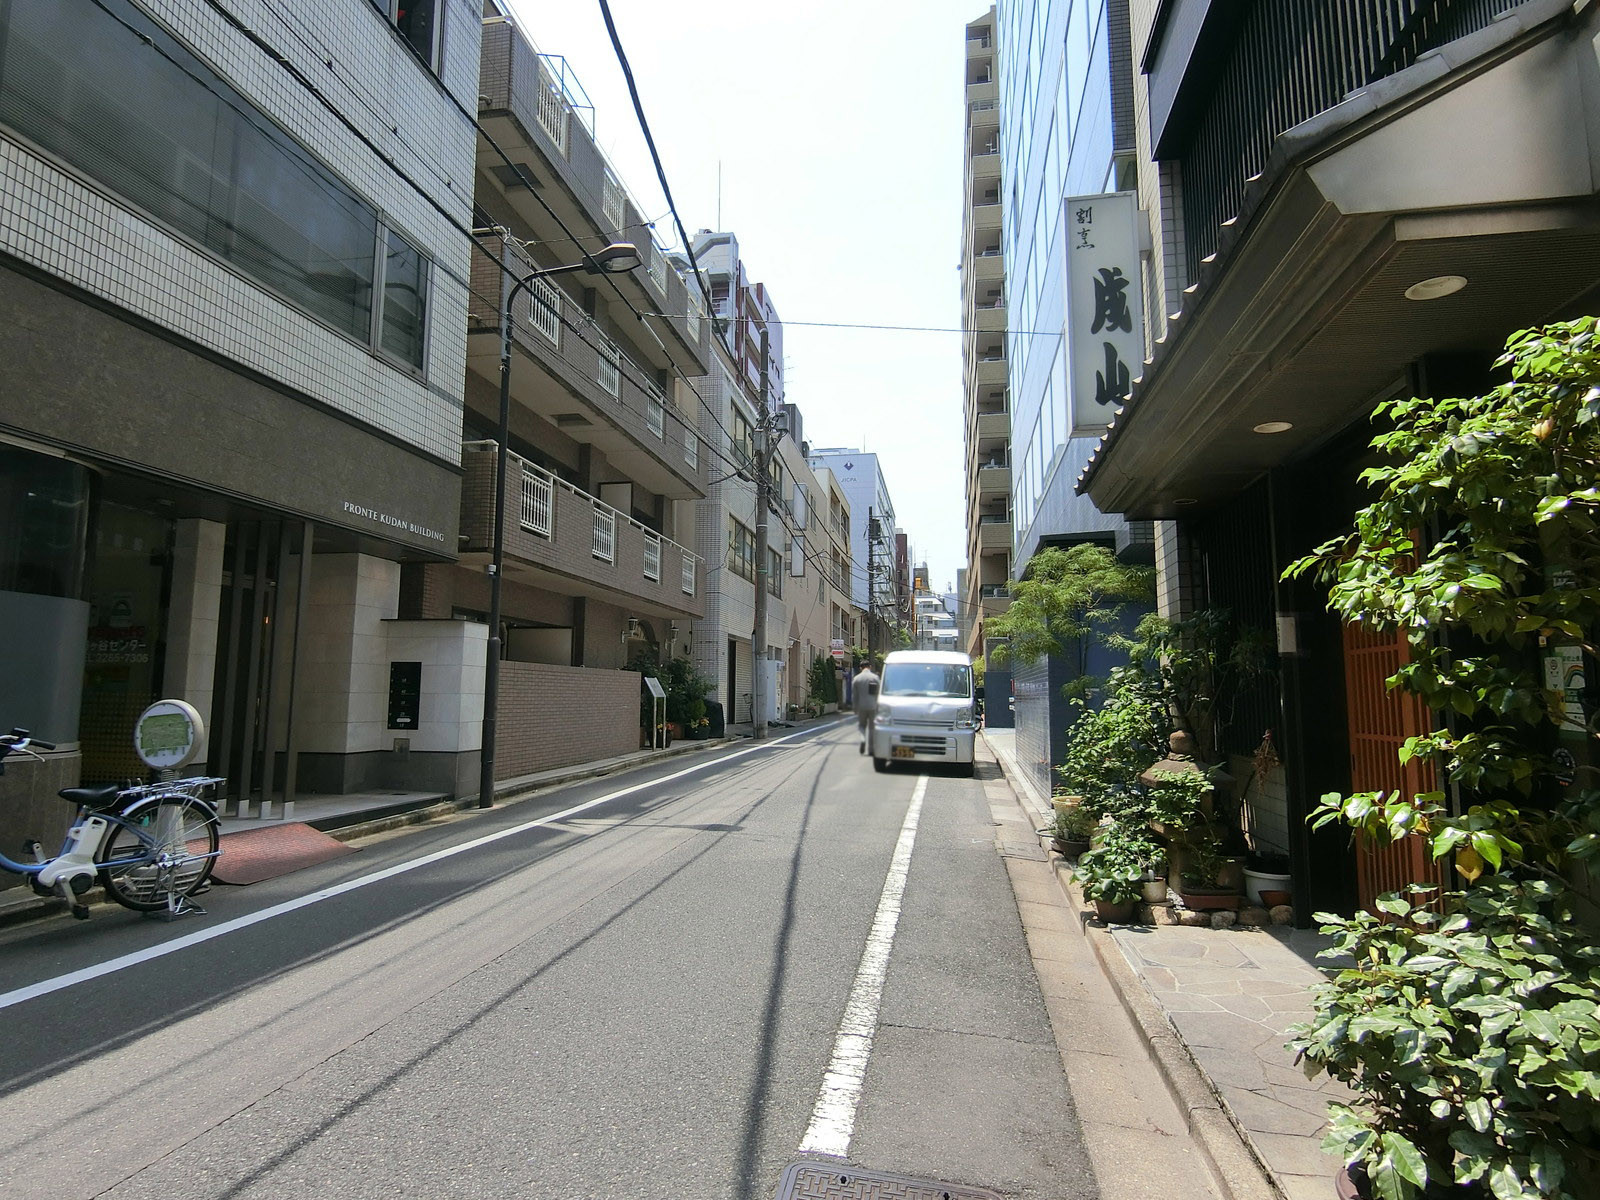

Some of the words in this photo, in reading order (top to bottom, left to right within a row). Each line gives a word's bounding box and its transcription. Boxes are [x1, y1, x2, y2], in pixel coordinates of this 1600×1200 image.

[1076, 206, 1095, 250] 割烹
[344, 502, 378, 520] PRONTE
[380, 513, 408, 530] KUDAN
[409, 523, 444, 541] BUILDING
